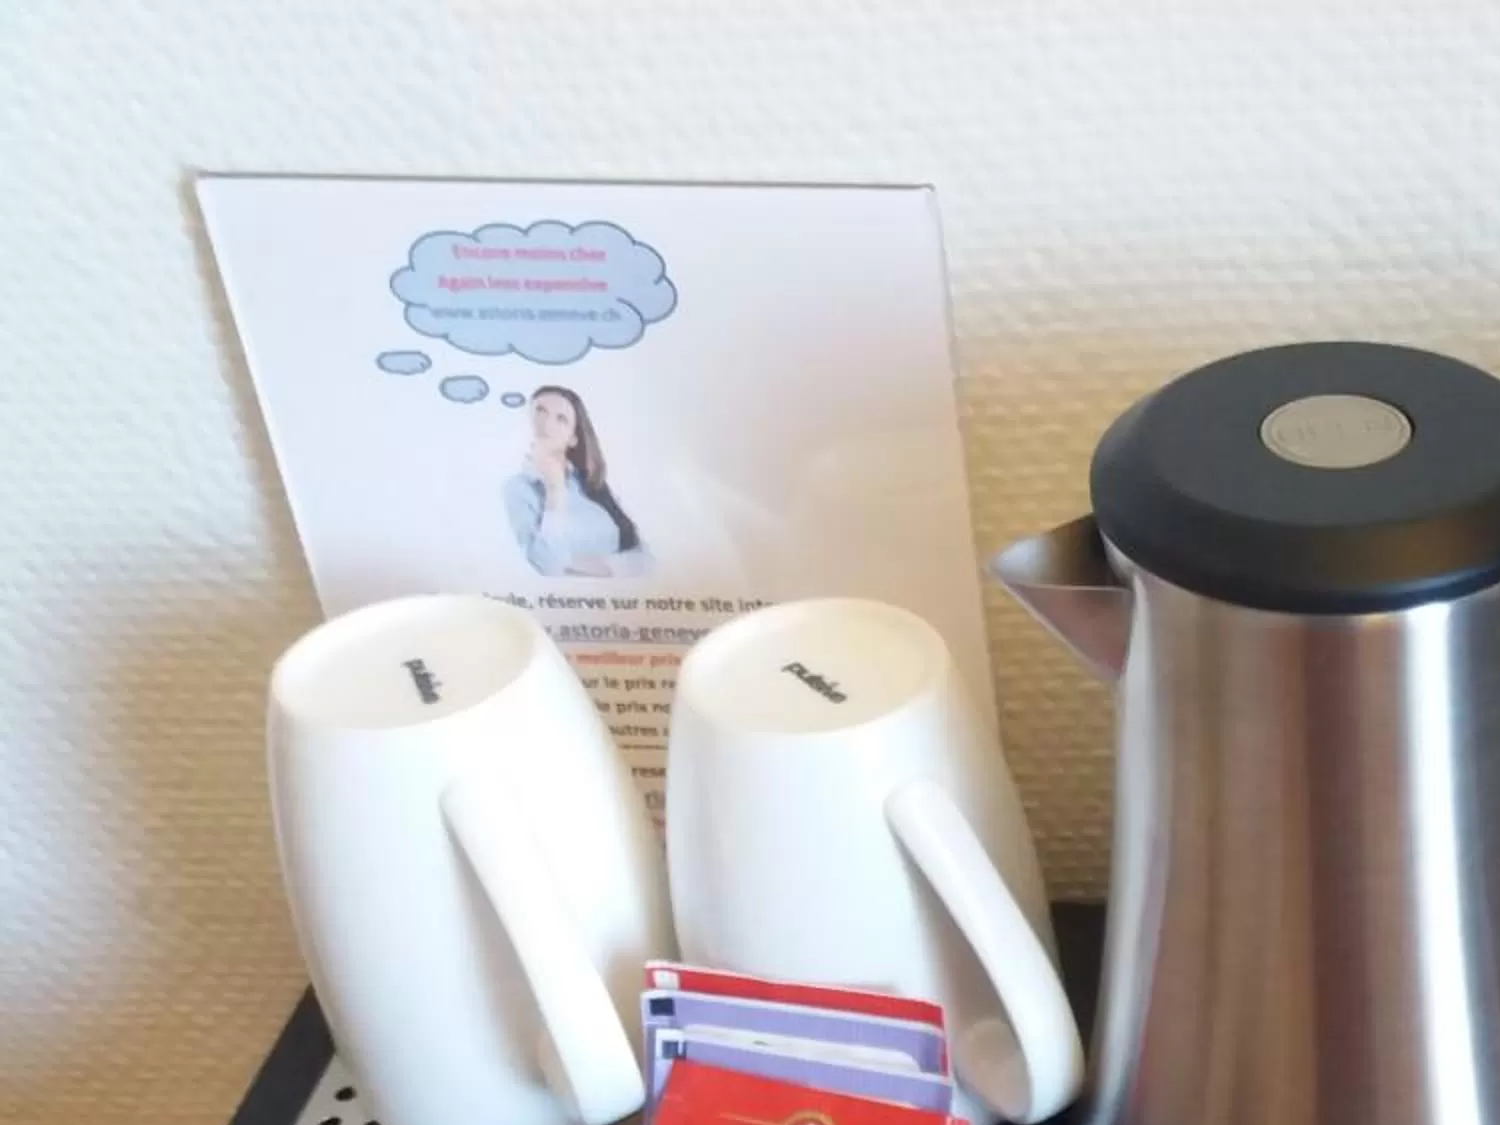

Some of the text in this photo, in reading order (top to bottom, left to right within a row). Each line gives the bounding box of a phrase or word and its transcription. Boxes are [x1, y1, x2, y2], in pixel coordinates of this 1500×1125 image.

[538, 593, 606, 609] réserve
[611, 596, 639, 610] sur
[645, 597, 696, 612] notre
[700, 597, 734, 613] site
